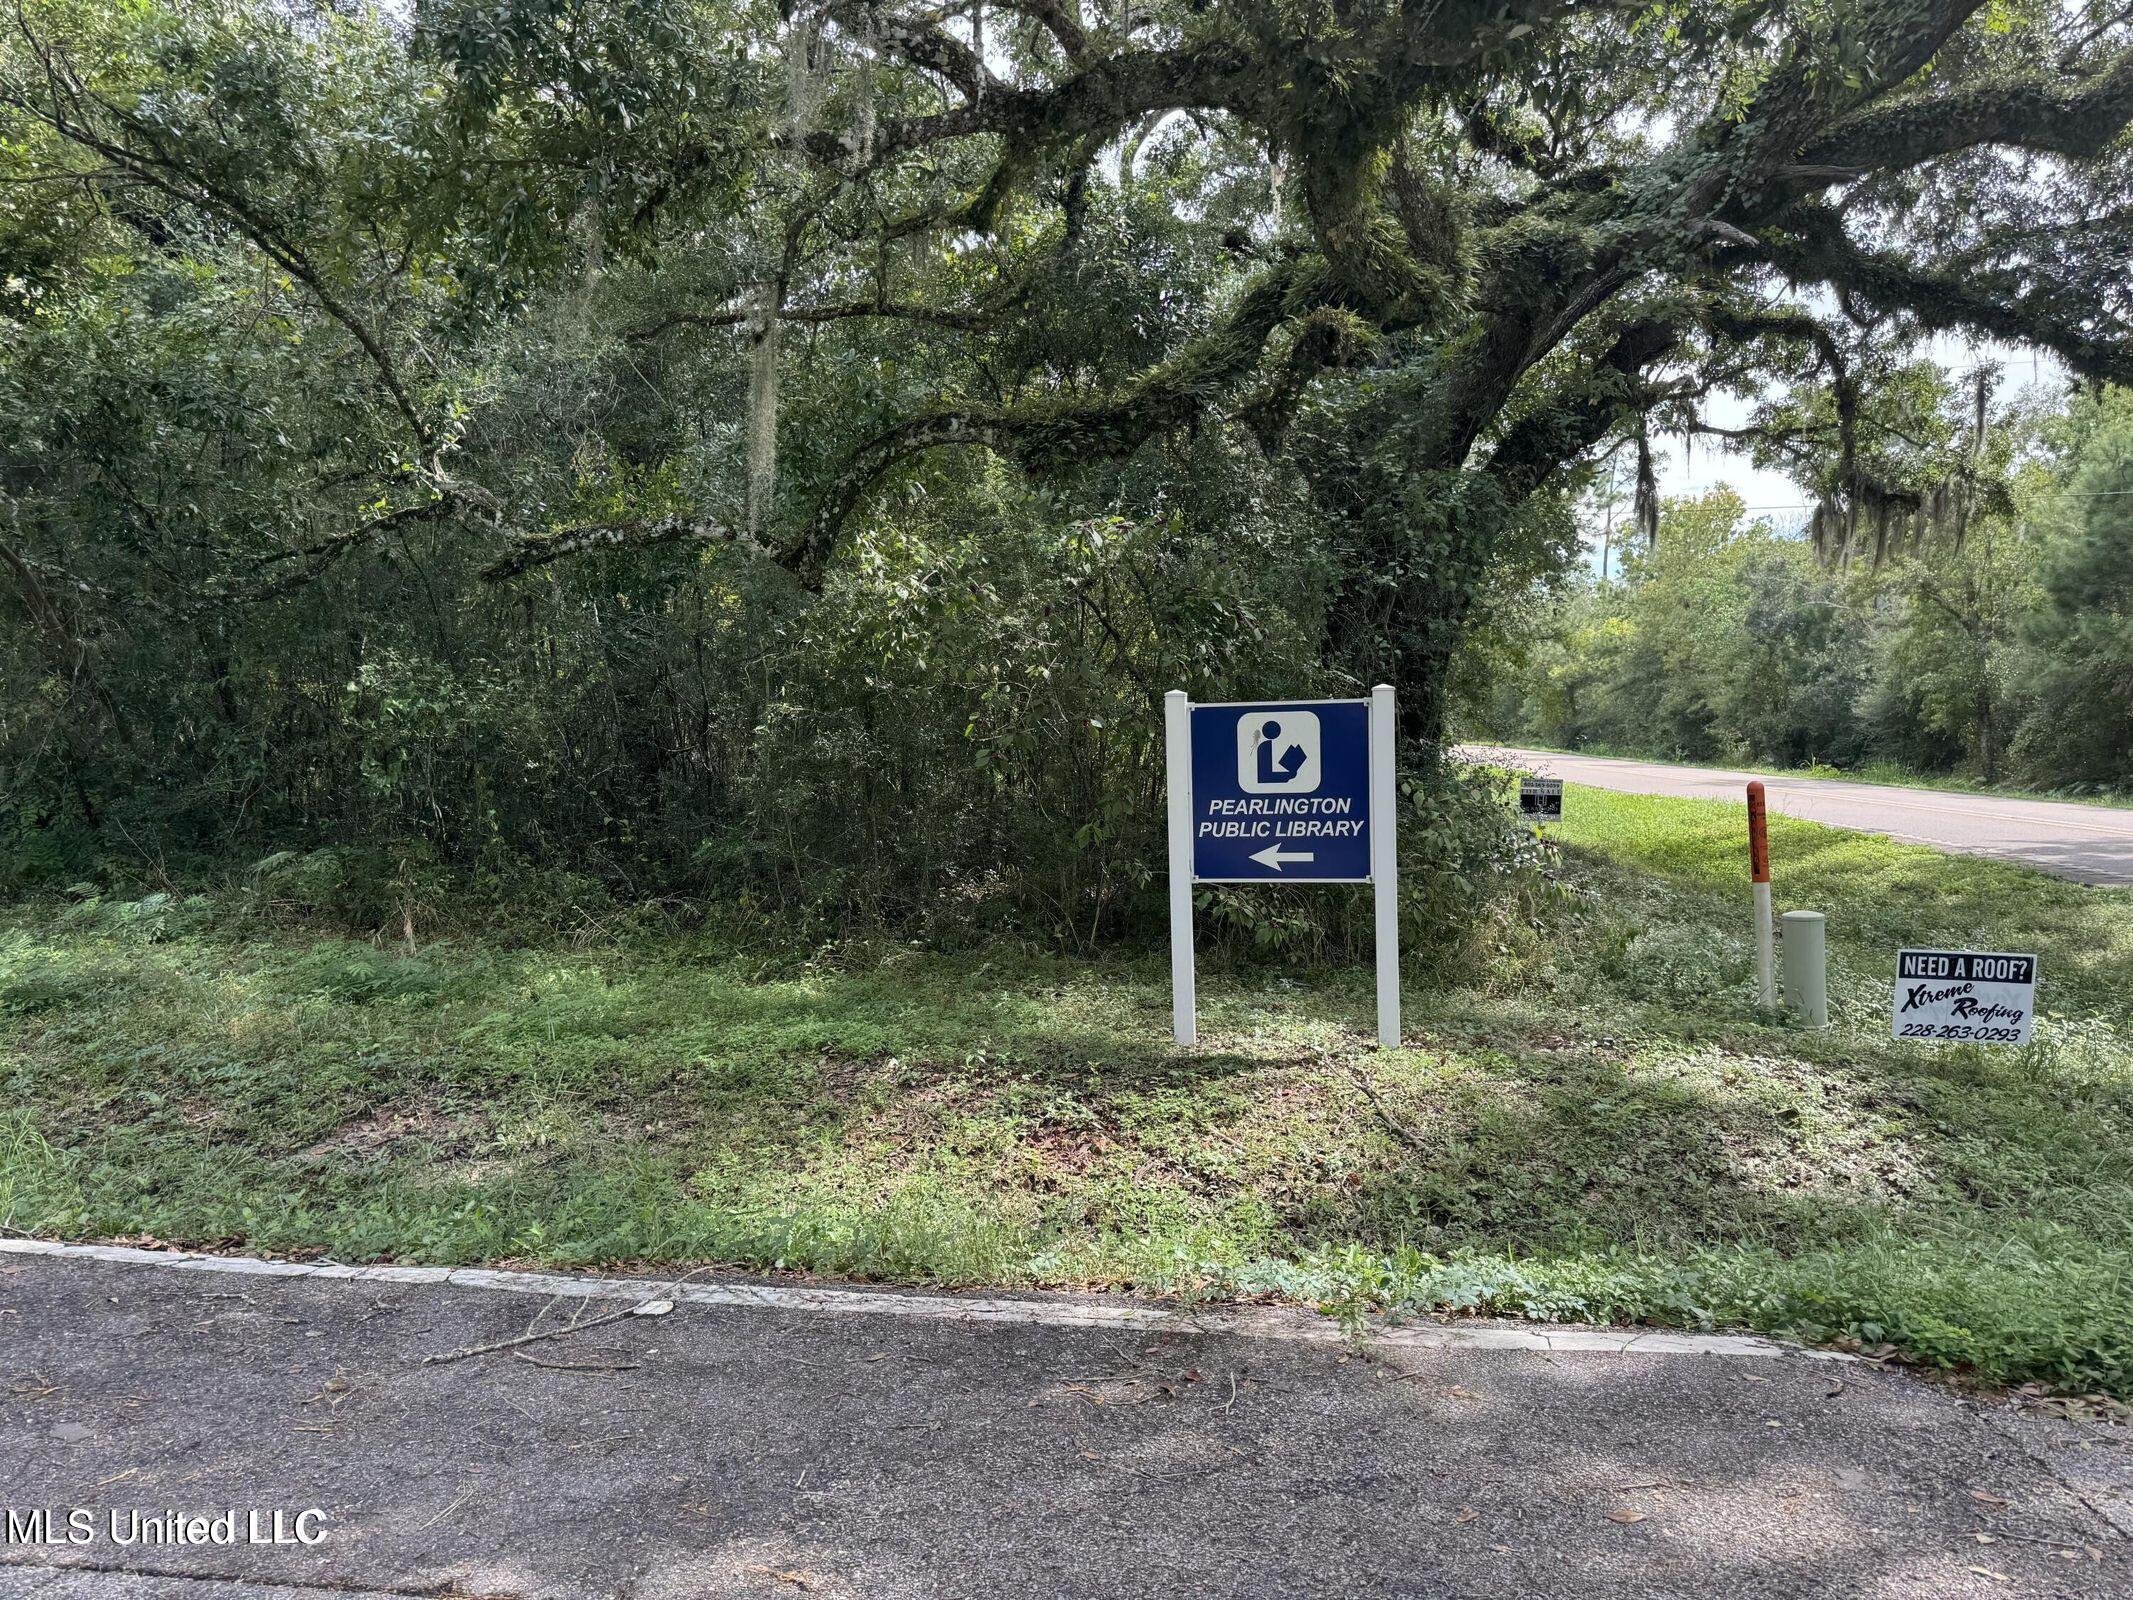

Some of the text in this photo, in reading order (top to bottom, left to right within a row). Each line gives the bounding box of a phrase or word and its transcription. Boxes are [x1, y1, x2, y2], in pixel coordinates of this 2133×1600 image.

[1208, 797, 1351, 815] PEARLINGTON
[1199, 820, 1364, 838] PUBLIC LIBRARY
[1904, 955, 2028, 980] NEED A ROOF?
[1901, 982, 1975, 1013] Xtreme
[1950, 997, 2024, 1025] Roofing
[1900, 1023, 2021, 1042] 228-263-0293
